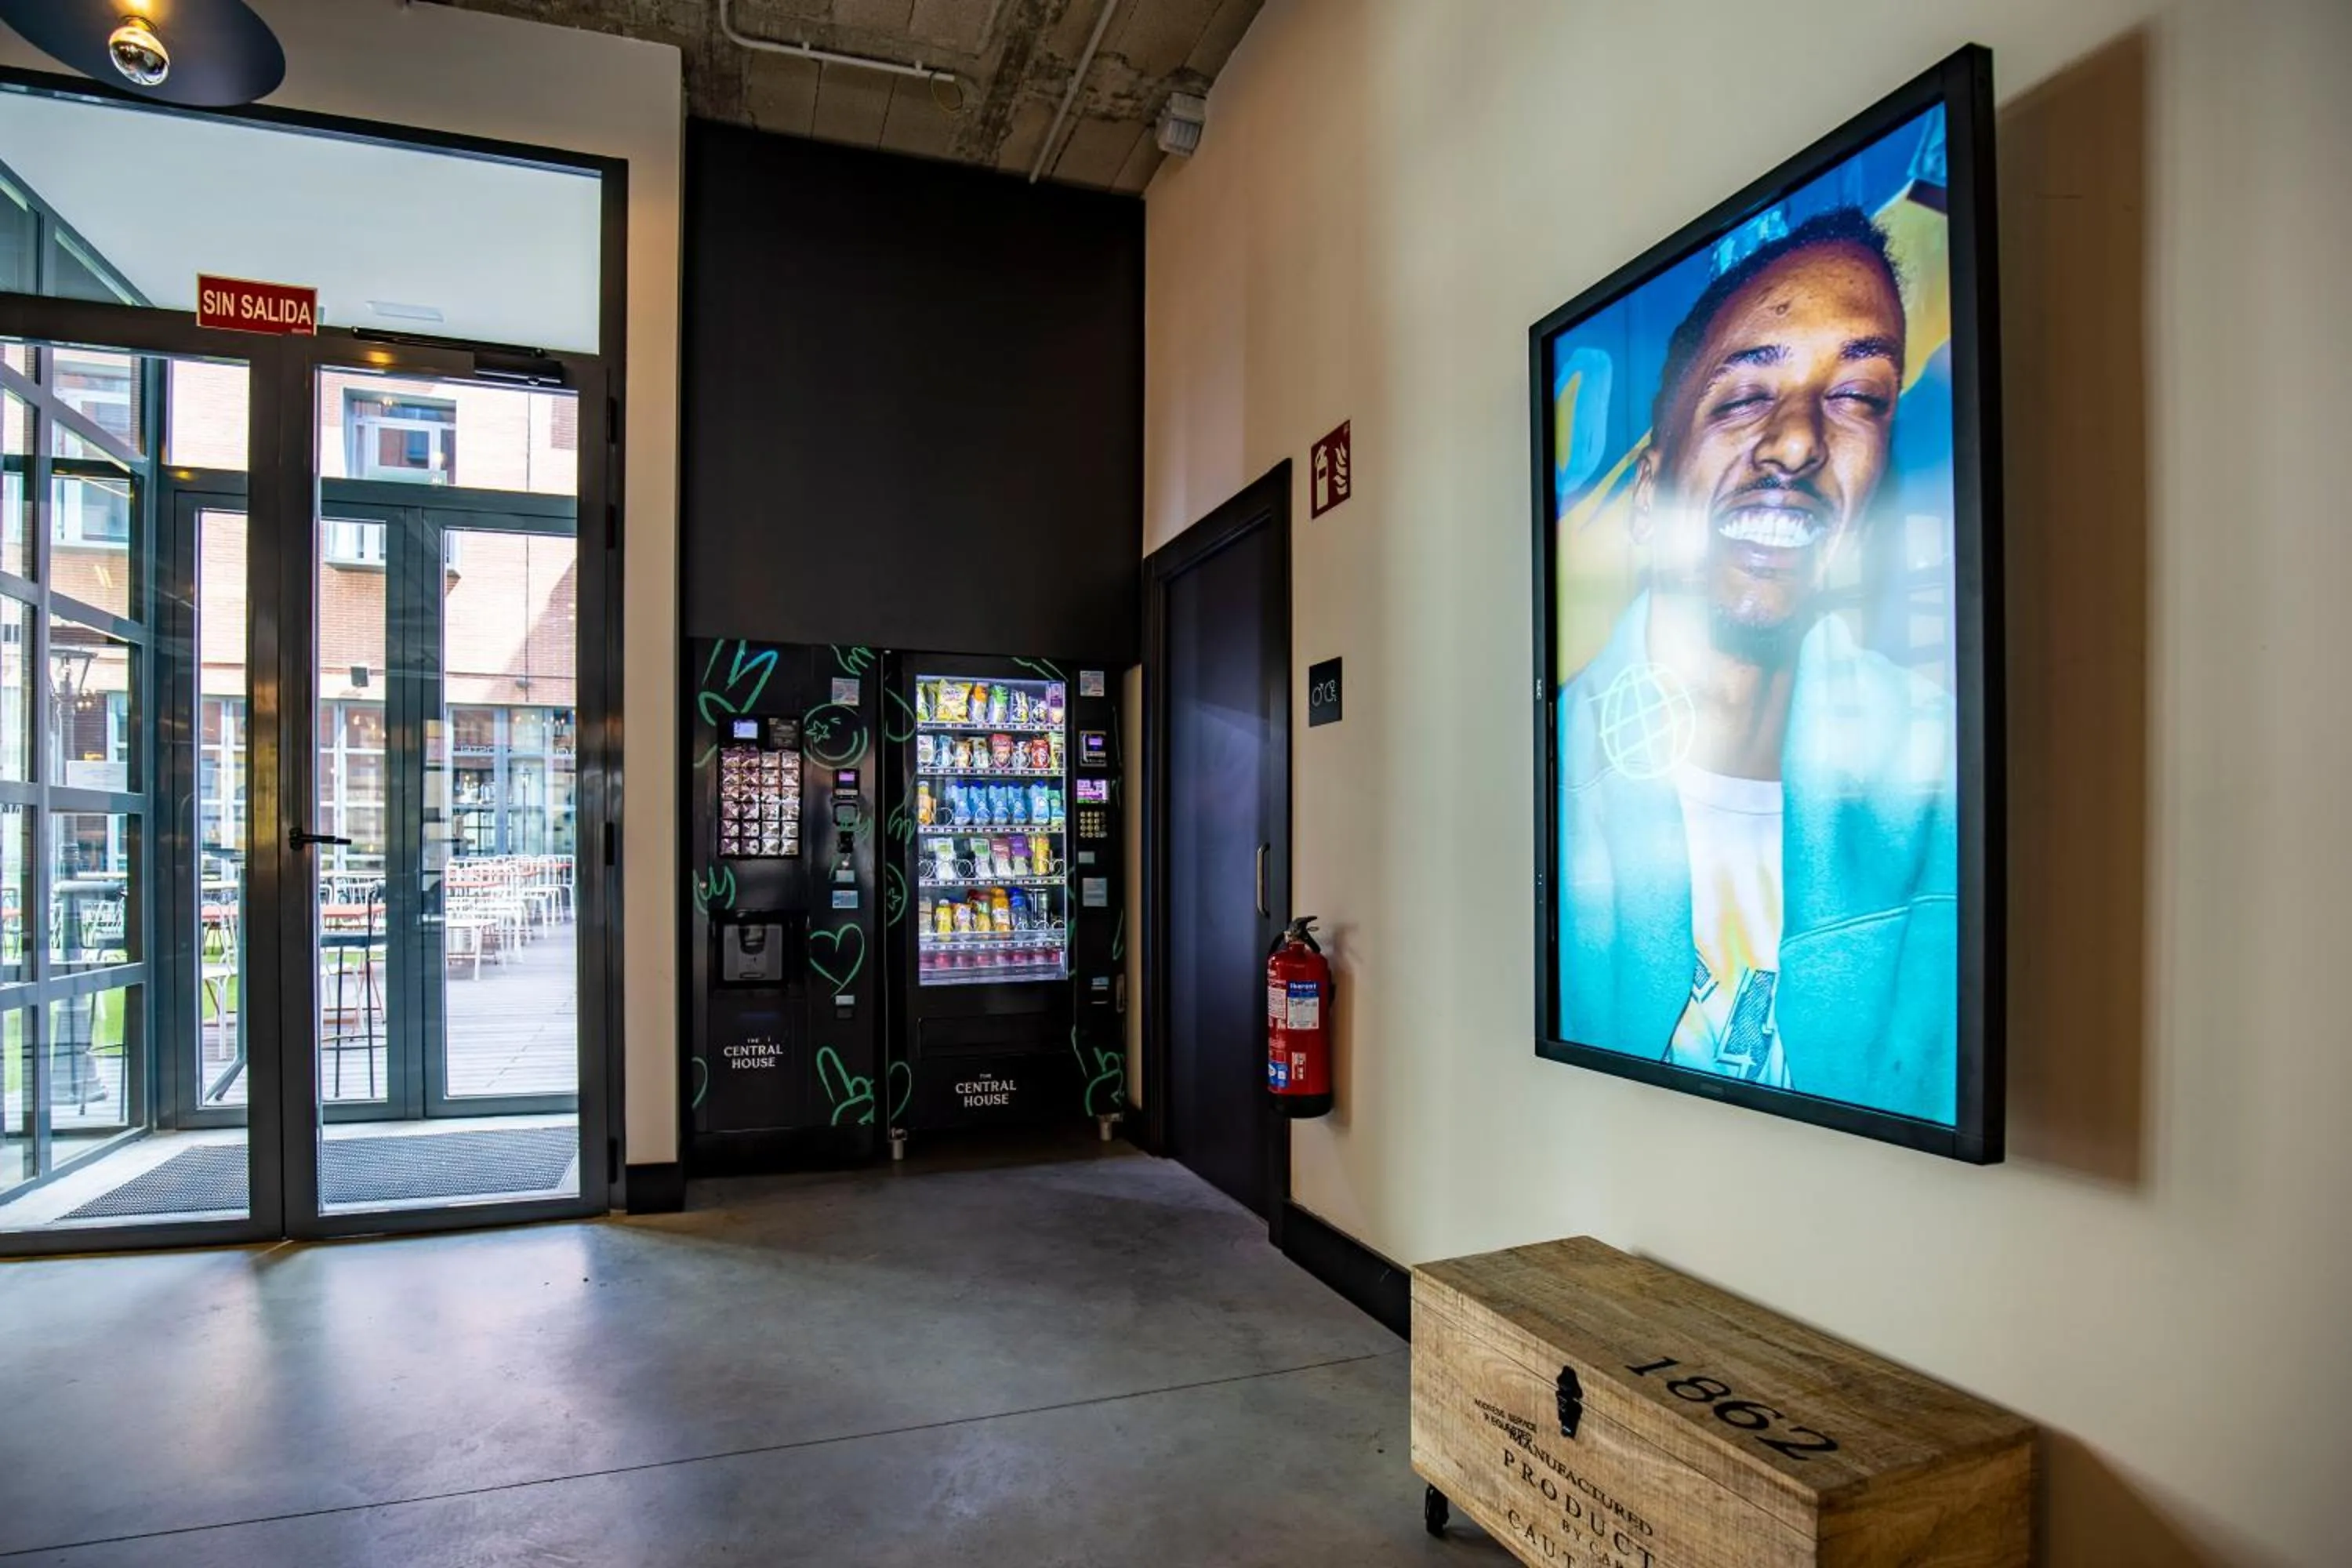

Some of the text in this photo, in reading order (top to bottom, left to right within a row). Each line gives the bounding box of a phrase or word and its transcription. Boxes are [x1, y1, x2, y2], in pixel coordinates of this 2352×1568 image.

[203, 289, 311, 325] SIN SALIDA
[724, 1044, 783, 1057] CENTRAL
[731, 1056, 775, 1069] HOUSE
[955, 1080, 1016, 1094] CENTRAL
[964, 1093, 1009, 1108] HOUSE
[1624, 1356, 1838, 1461] 1862
[1509, 1430, 1653, 1537] MANUFACTURED
[1503, 1448, 1655, 1568] PRODUCT
[1562, 1519, 1581, 1541] BY
